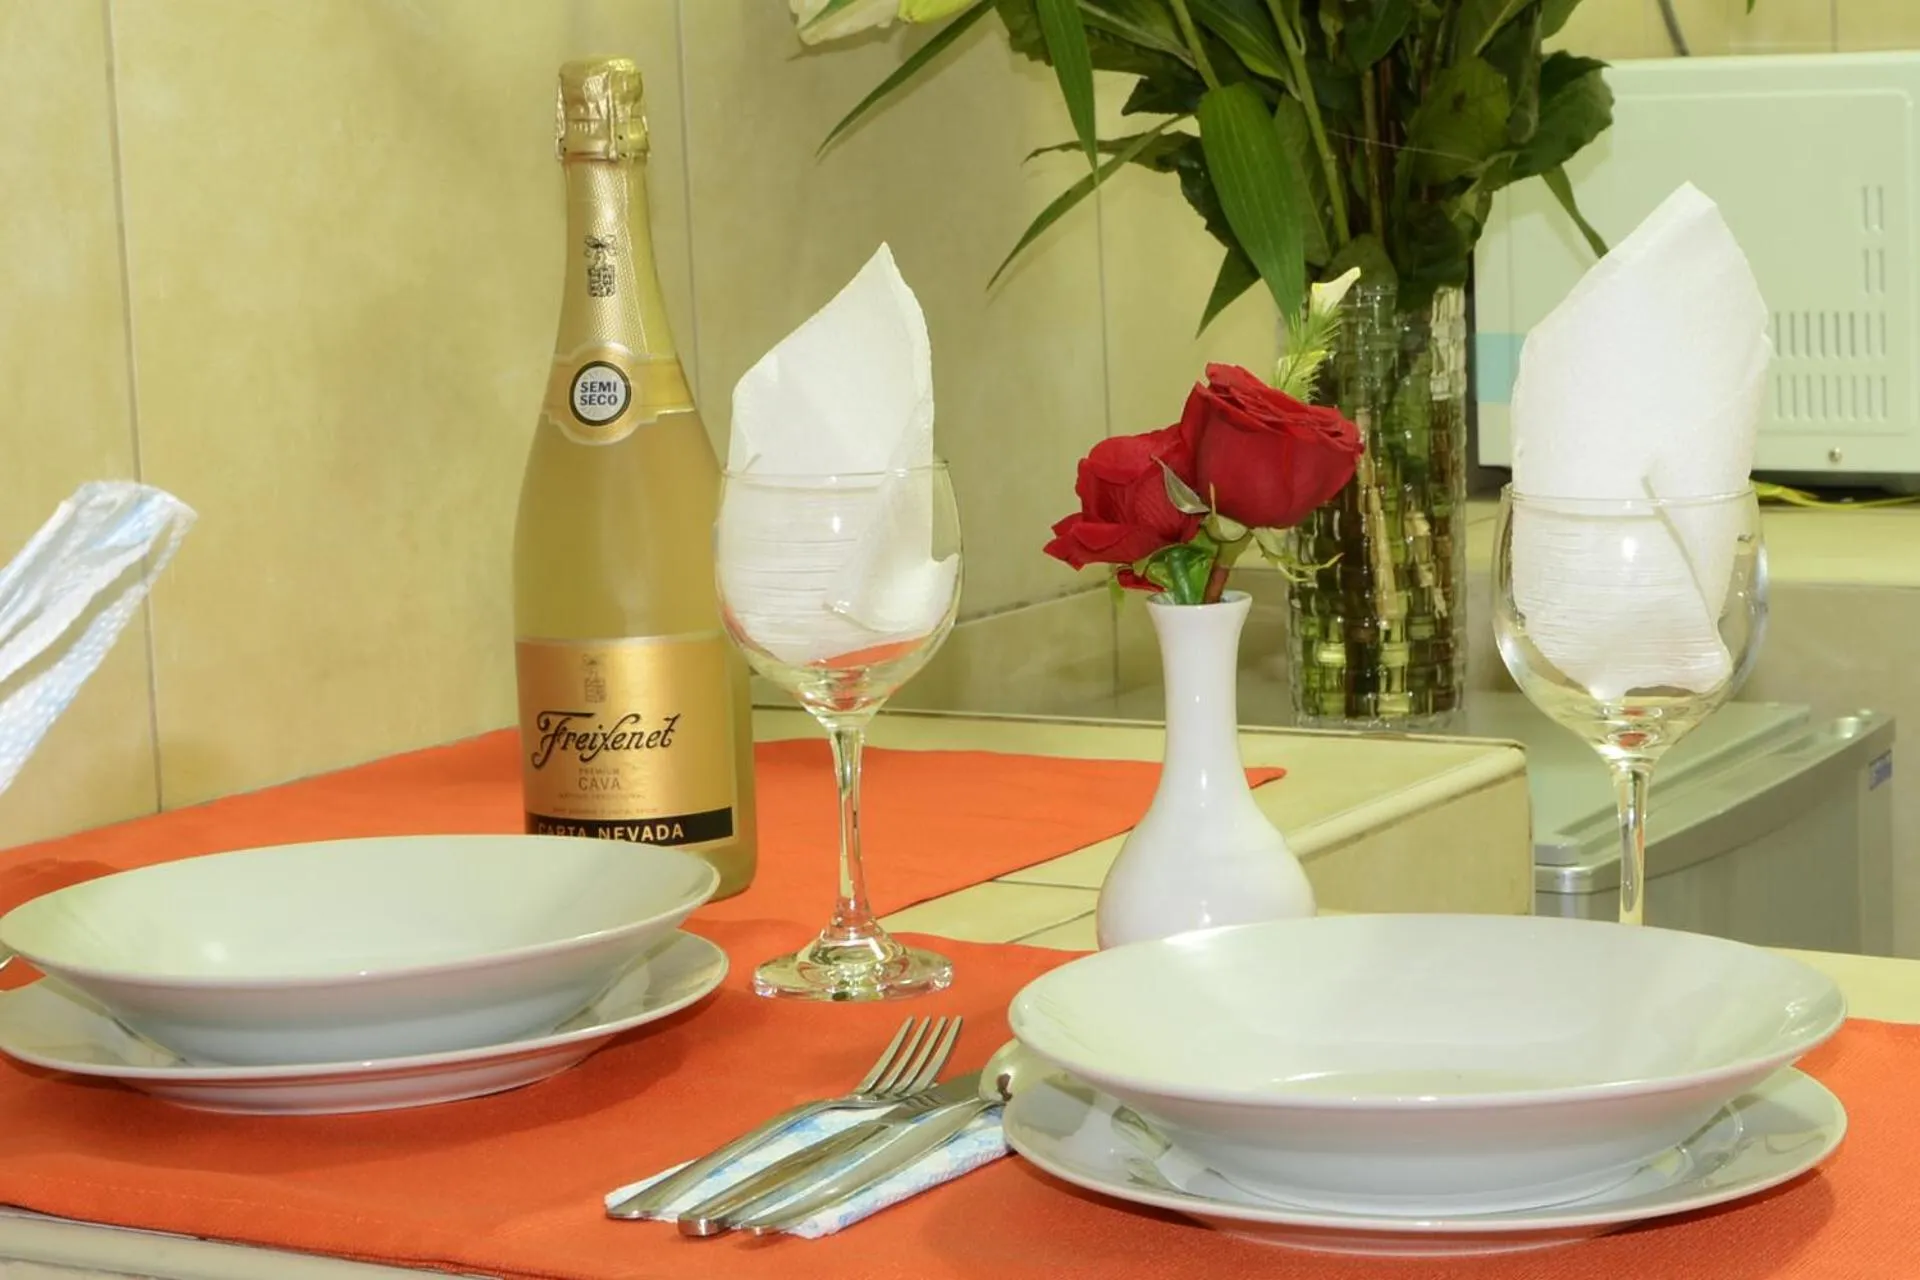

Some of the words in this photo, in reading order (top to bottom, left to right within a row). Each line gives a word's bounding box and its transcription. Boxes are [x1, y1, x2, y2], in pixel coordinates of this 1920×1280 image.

[580, 381, 618, 393] SEMI
[580, 394, 618, 406] SECO
[531, 710, 682, 770] Freixenet
[578, 776, 621, 791] CAVA
[598, 823, 685, 842] NEVADA
